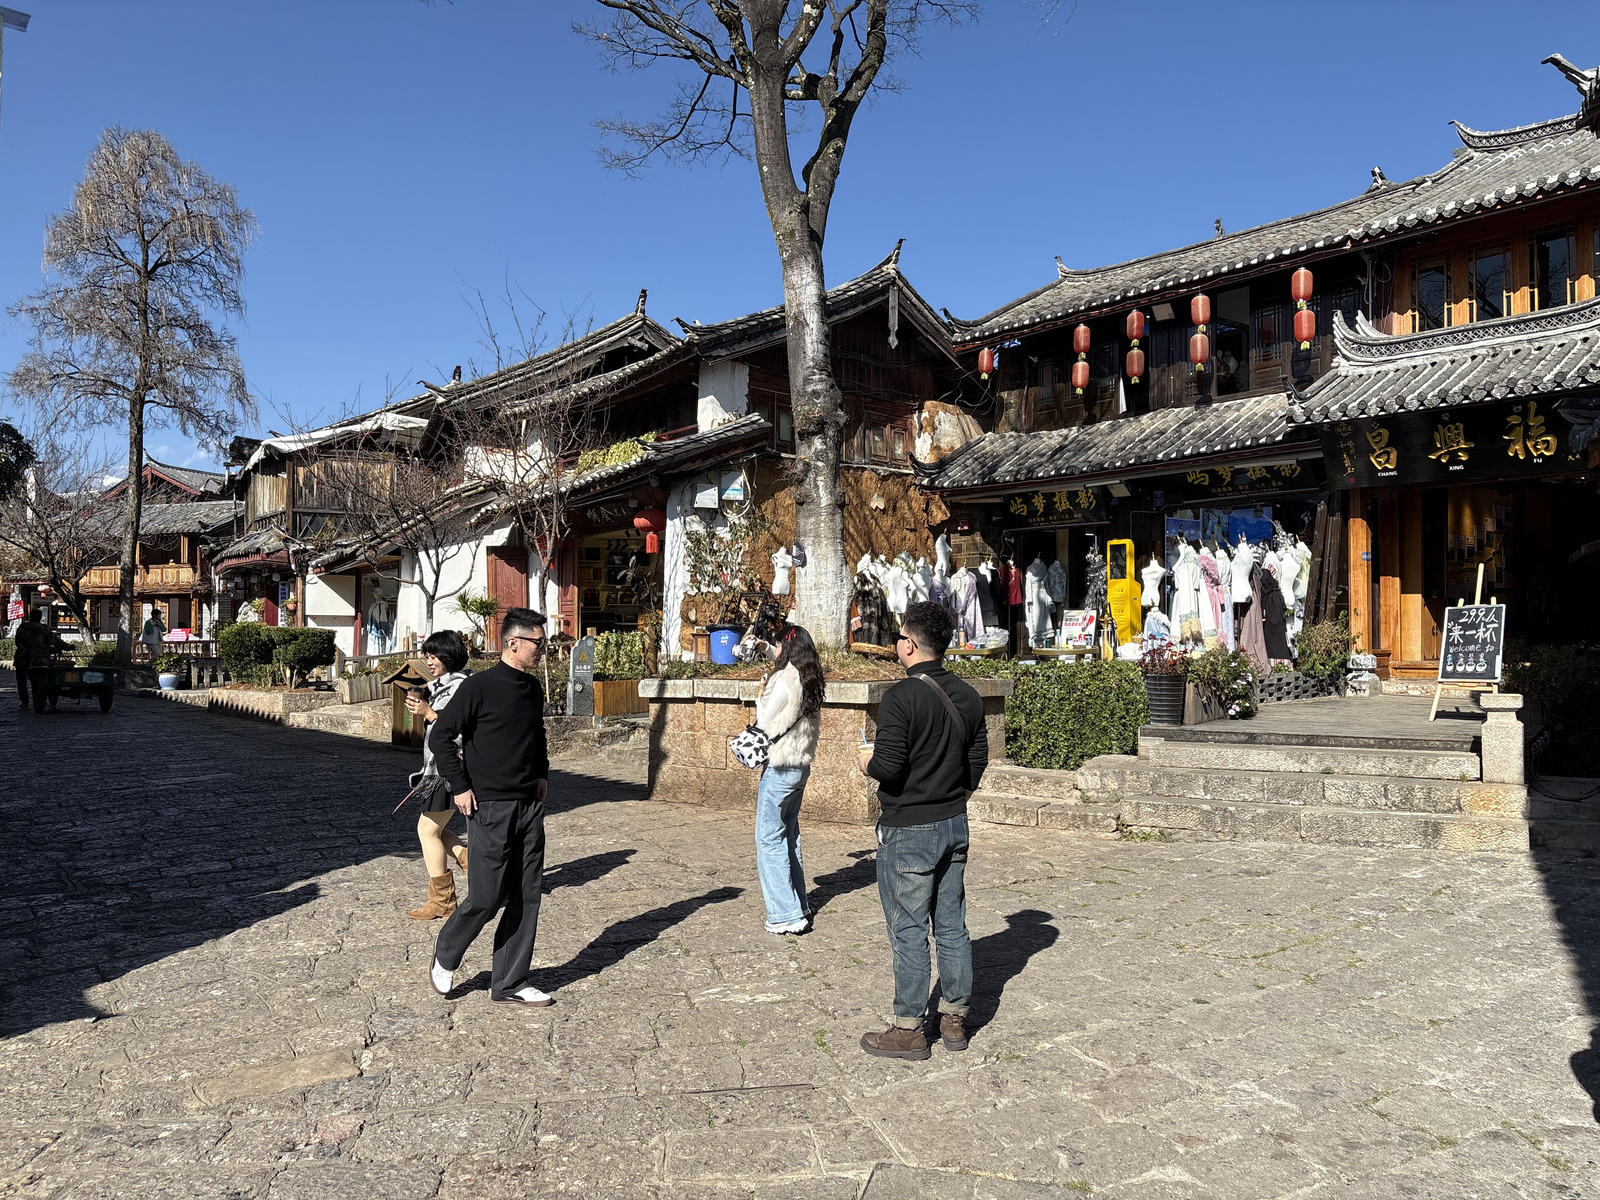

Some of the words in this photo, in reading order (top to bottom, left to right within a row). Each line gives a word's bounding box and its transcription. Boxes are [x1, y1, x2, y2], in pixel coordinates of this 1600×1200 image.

[1010, 488, 1096, 516] 屿梦摄影
[1449, 622, 1499, 644] 来一杯
[1485, 644, 1495, 653] to
